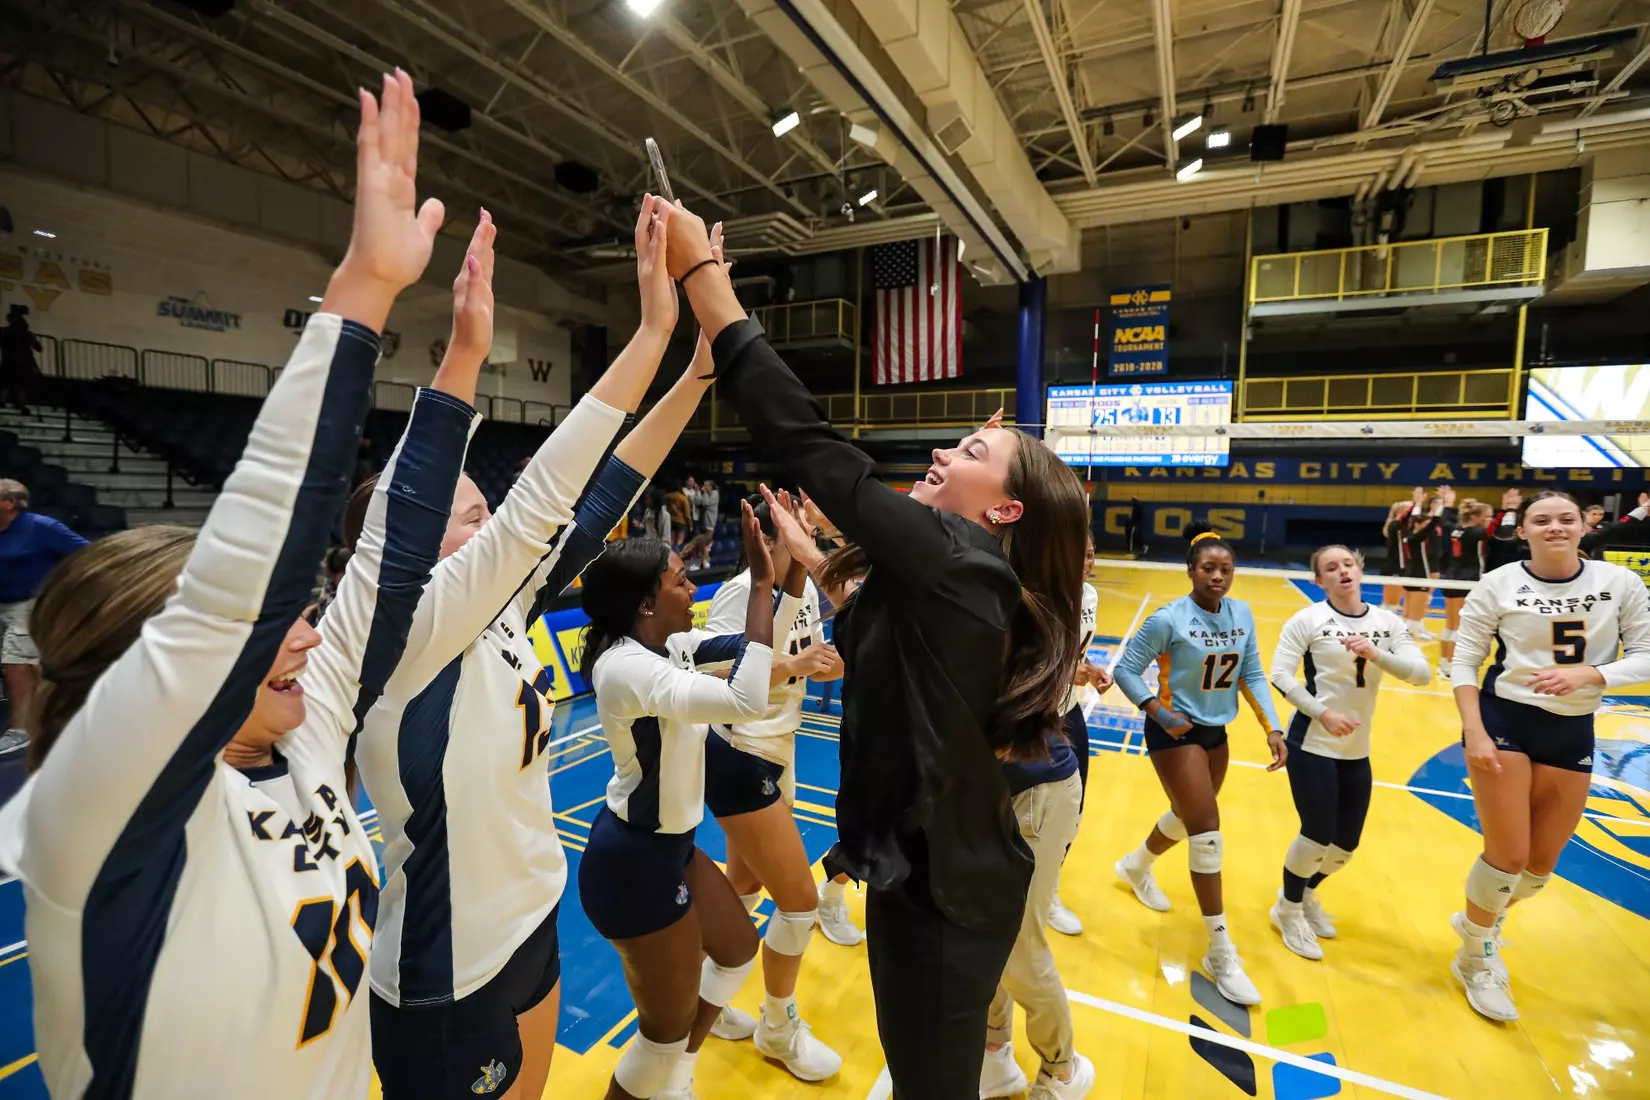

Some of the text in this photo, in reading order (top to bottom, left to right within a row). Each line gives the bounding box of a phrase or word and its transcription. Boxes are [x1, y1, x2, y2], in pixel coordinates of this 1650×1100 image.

[156, 301, 241, 330] SUMMIT
[1114, 325, 1165, 344] NCAA
[1113, 341, 1164, 352] TOURNAMENT
[1051, 382, 1228, 397] KANSAS CITY VOLLEYBALL
[1094, 408, 1116, 424] 25
[1159, 407, 1178, 424] 13
[1182, 454, 1219, 466] evergy
[1125, 462, 1276, 479] KANSAS
[1299, 462, 1400, 480] CITY
[1516, 592, 1612, 607] KANSAS
[1539, 603, 1594, 614] CITY
[1189, 629, 1245, 640] KANSAS
[1204, 639, 1237, 648] CITY
[1551, 619, 1588, 667] 5
[1201, 651, 1241, 692] 12
[1353, 655, 1368, 689] 1
